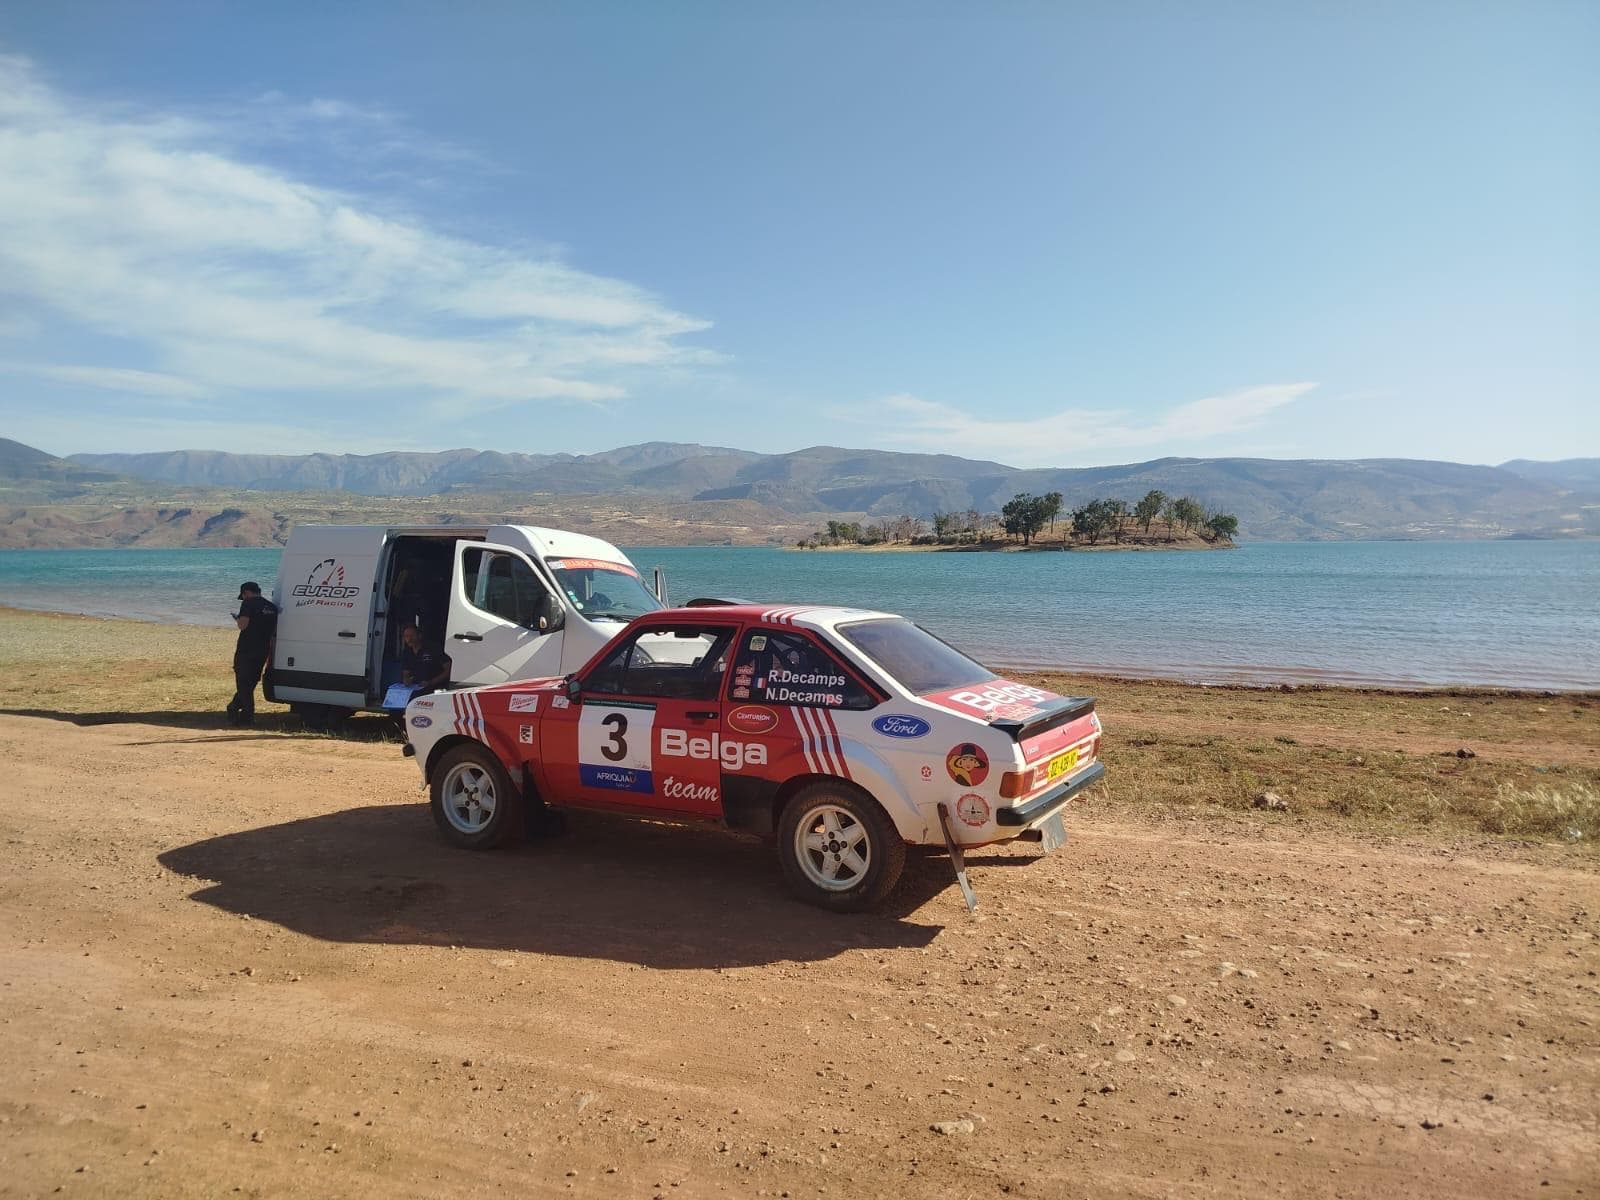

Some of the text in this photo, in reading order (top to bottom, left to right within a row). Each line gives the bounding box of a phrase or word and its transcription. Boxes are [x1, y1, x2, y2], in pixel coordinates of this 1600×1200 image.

[292, 585, 360, 598] EUROP
[315, 600, 353, 608] Racing
[768, 669, 846, 686] R.Decamps
[765, 687, 843, 705] N.Decamps
[948, 684, 1046, 711] Belga
[882, 716, 919, 735] Ford
[600, 712, 628, 761] 3
[660, 728, 768, 771] Belga
[663, 776, 719, 801] team
